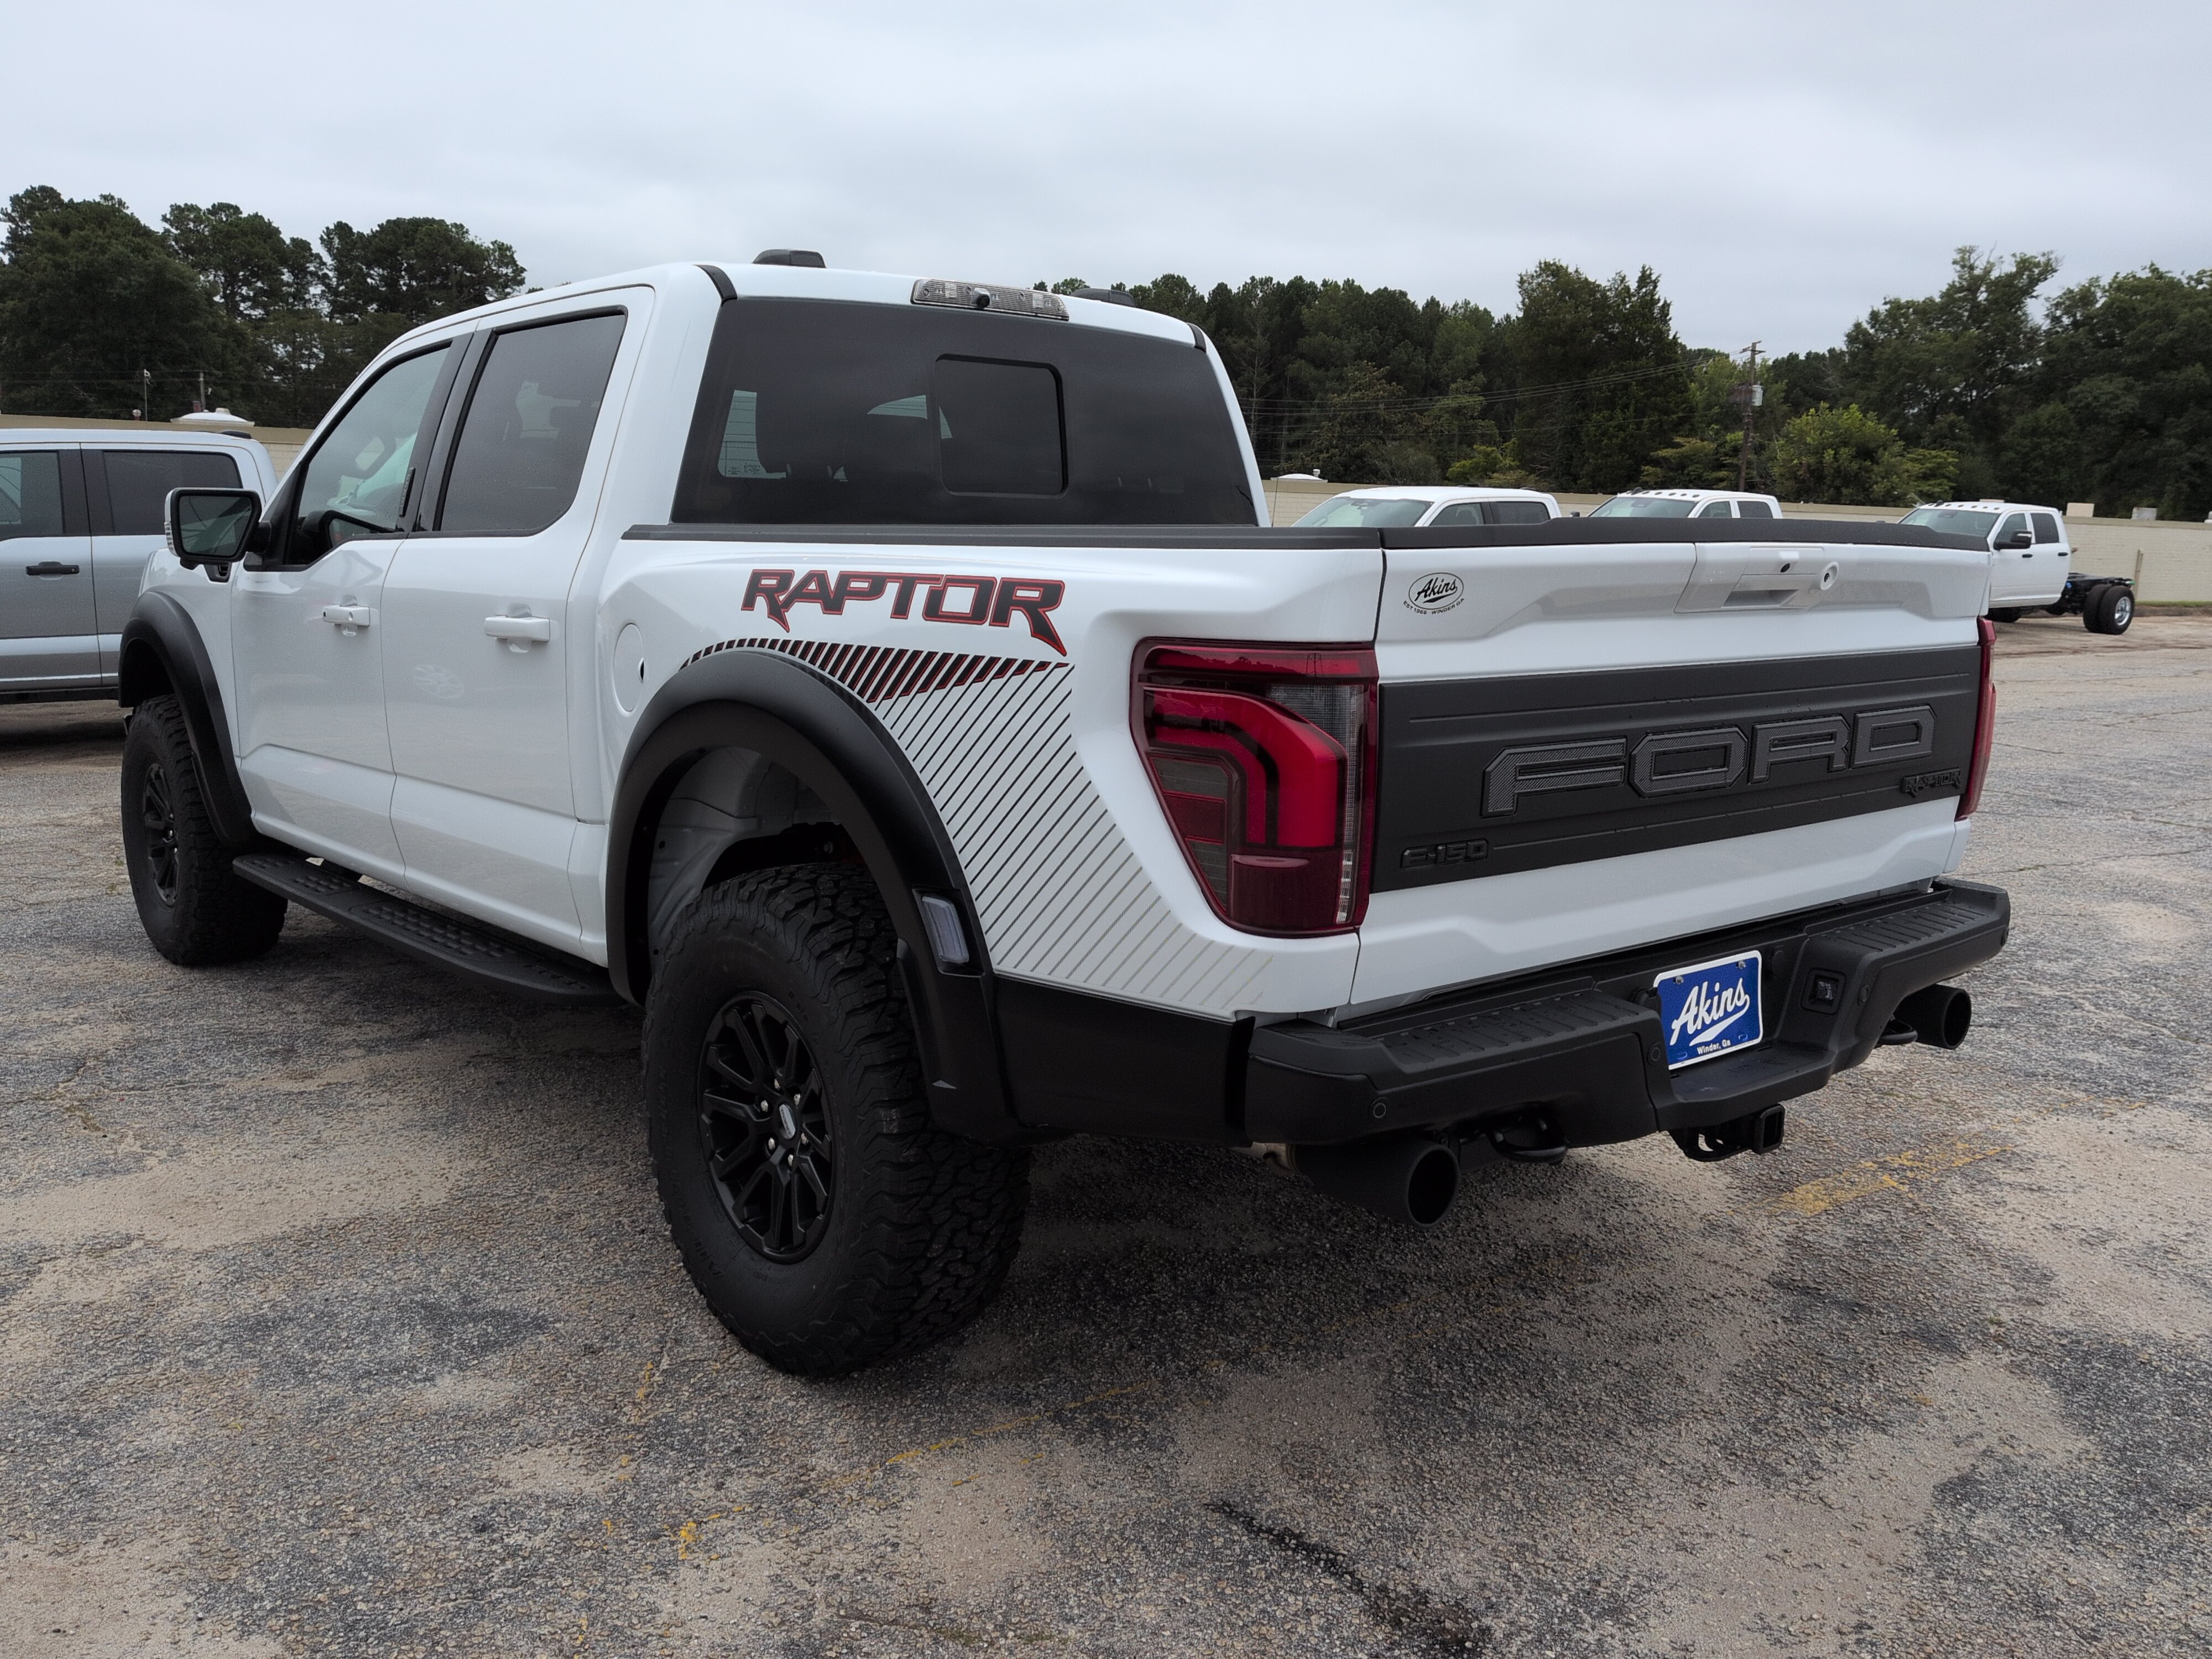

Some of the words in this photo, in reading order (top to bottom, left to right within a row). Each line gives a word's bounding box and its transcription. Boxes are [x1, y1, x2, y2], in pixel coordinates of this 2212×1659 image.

[1414, 577, 1458, 603] Akins
[741, 569, 1066, 656] RAPTOR
[1404, 600, 1413, 611] EST
[1431, 605, 1455, 615] WINDER
[1480, 703, 1937, 818] FORD
[1902, 768, 1961, 797] RAPTOR
[1400, 838, 1489, 869] F-150
[1670, 977, 1750, 1046] Akins
[1697, 1043, 1721, 1055] Winder,
[1721, 1039, 1731, 1047] Ga
